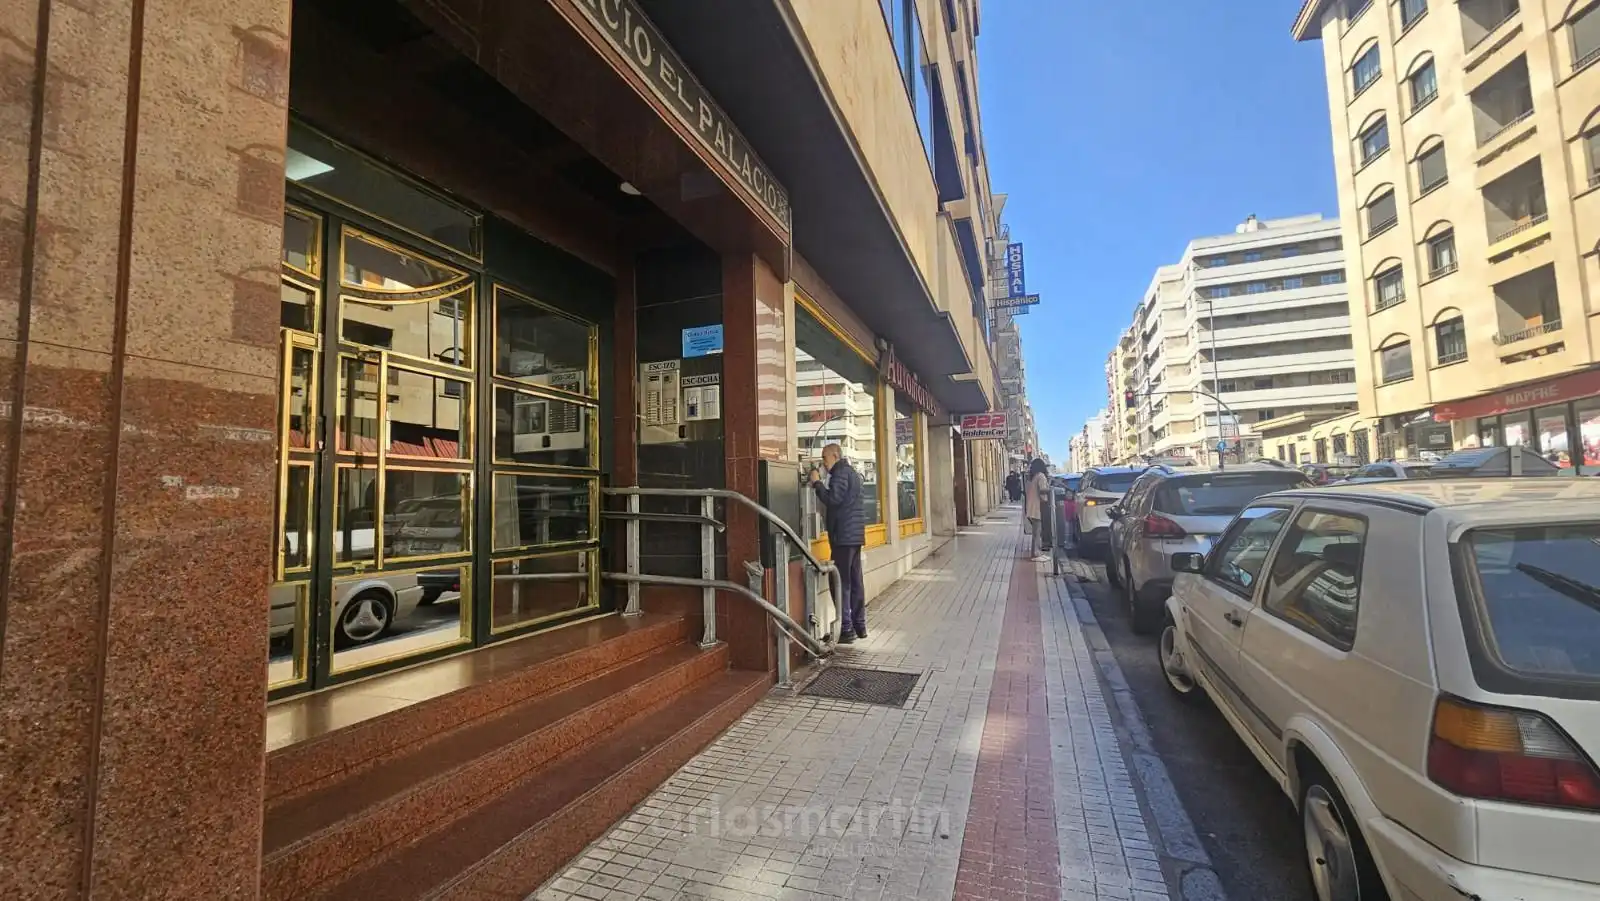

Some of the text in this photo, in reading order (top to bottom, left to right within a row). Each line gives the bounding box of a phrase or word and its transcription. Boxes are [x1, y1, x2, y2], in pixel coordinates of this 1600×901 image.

[659, 54, 694, 113] EL
[698, 97, 777, 210] PALACIO
[1009, 245, 1023, 294] HOSTAL
[682, 375, 718, 385] ESC-DCHA
[1505, 384, 1560, 405] MAPFRE
[962, 414, 1006, 428] 222
